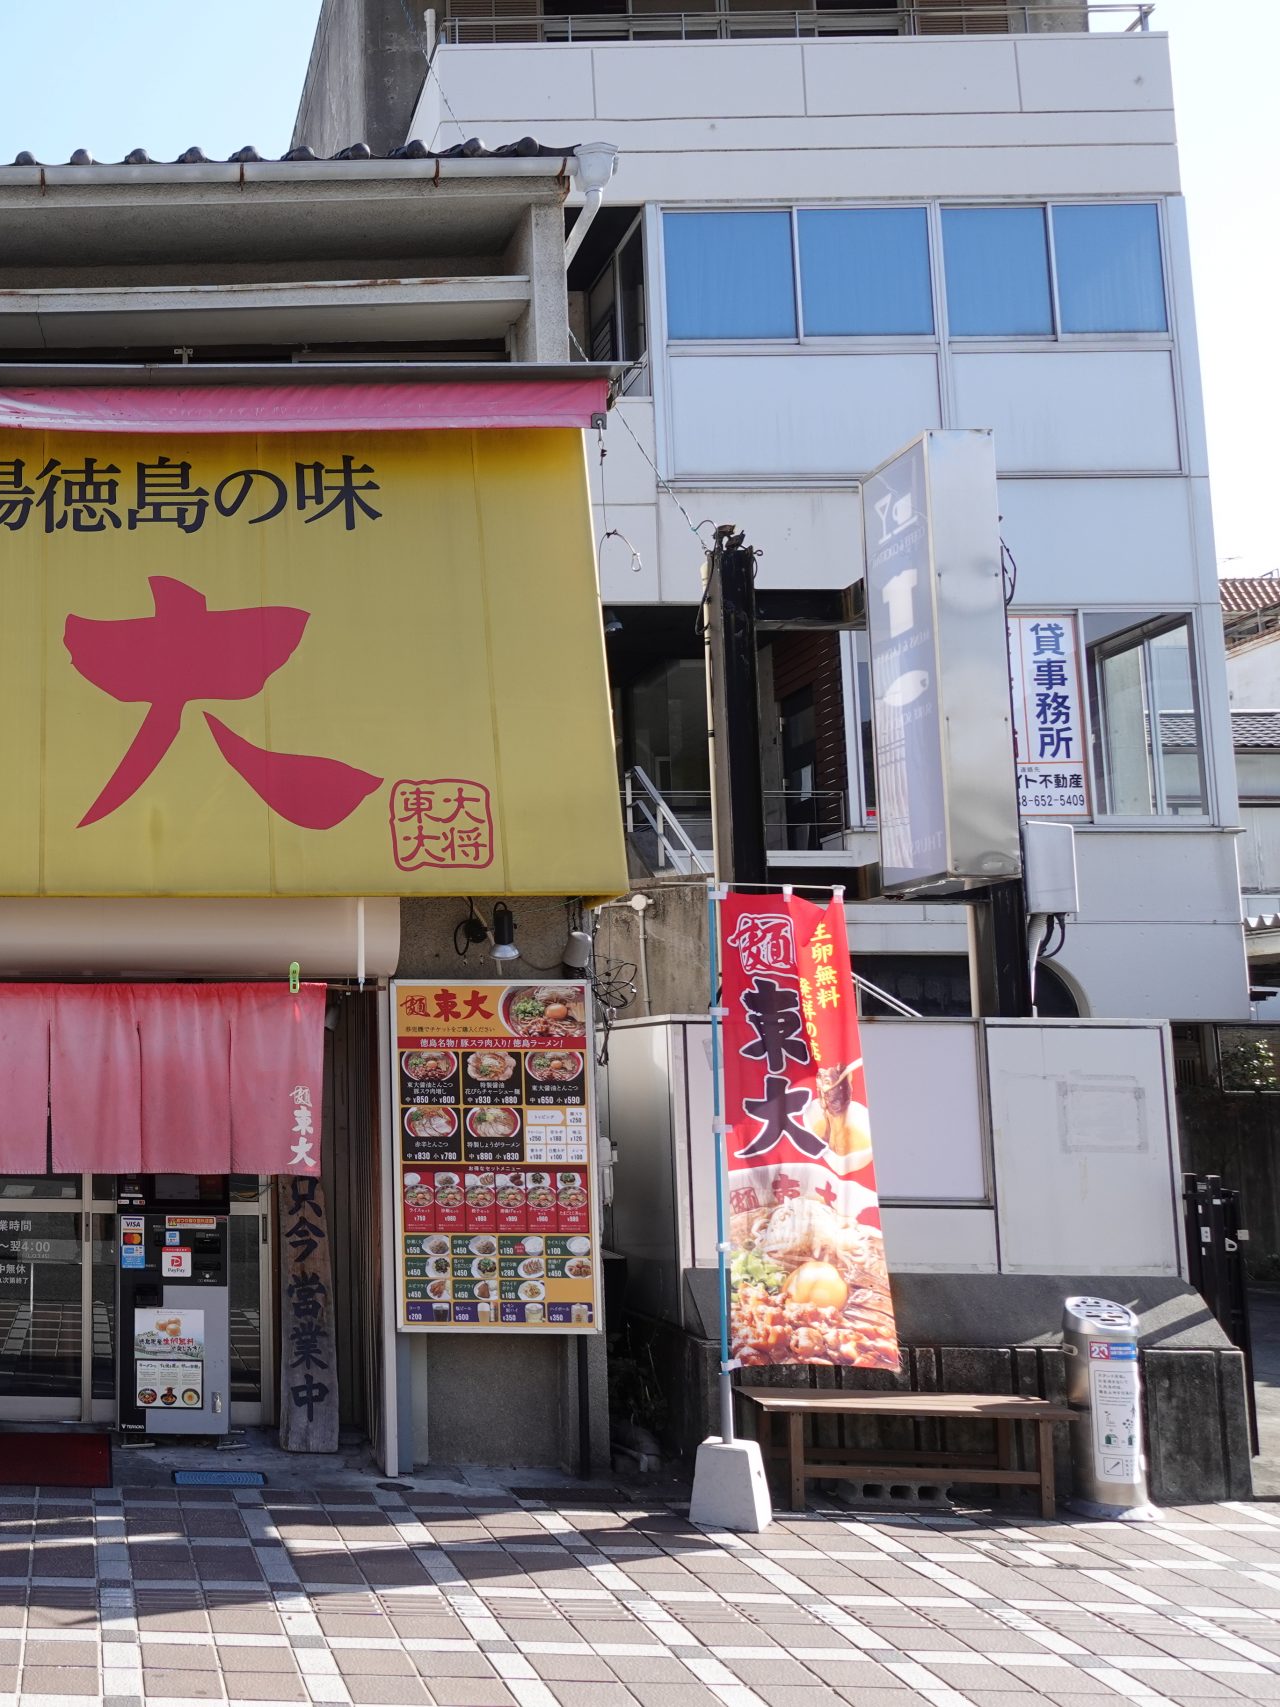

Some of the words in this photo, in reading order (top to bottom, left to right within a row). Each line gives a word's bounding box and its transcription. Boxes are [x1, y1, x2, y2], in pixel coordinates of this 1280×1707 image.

[1030, 623, 1073, 759] 貸事務所
[1019, 794, 1084, 807] 8-652-5409
[413, 1096, 429, 1104] ¥850
[439, 1096, 455, 1104] ¥800
[563, 1096, 580, 1104] ¥590
[284, 1176, 329, 1422] 只今営業中
